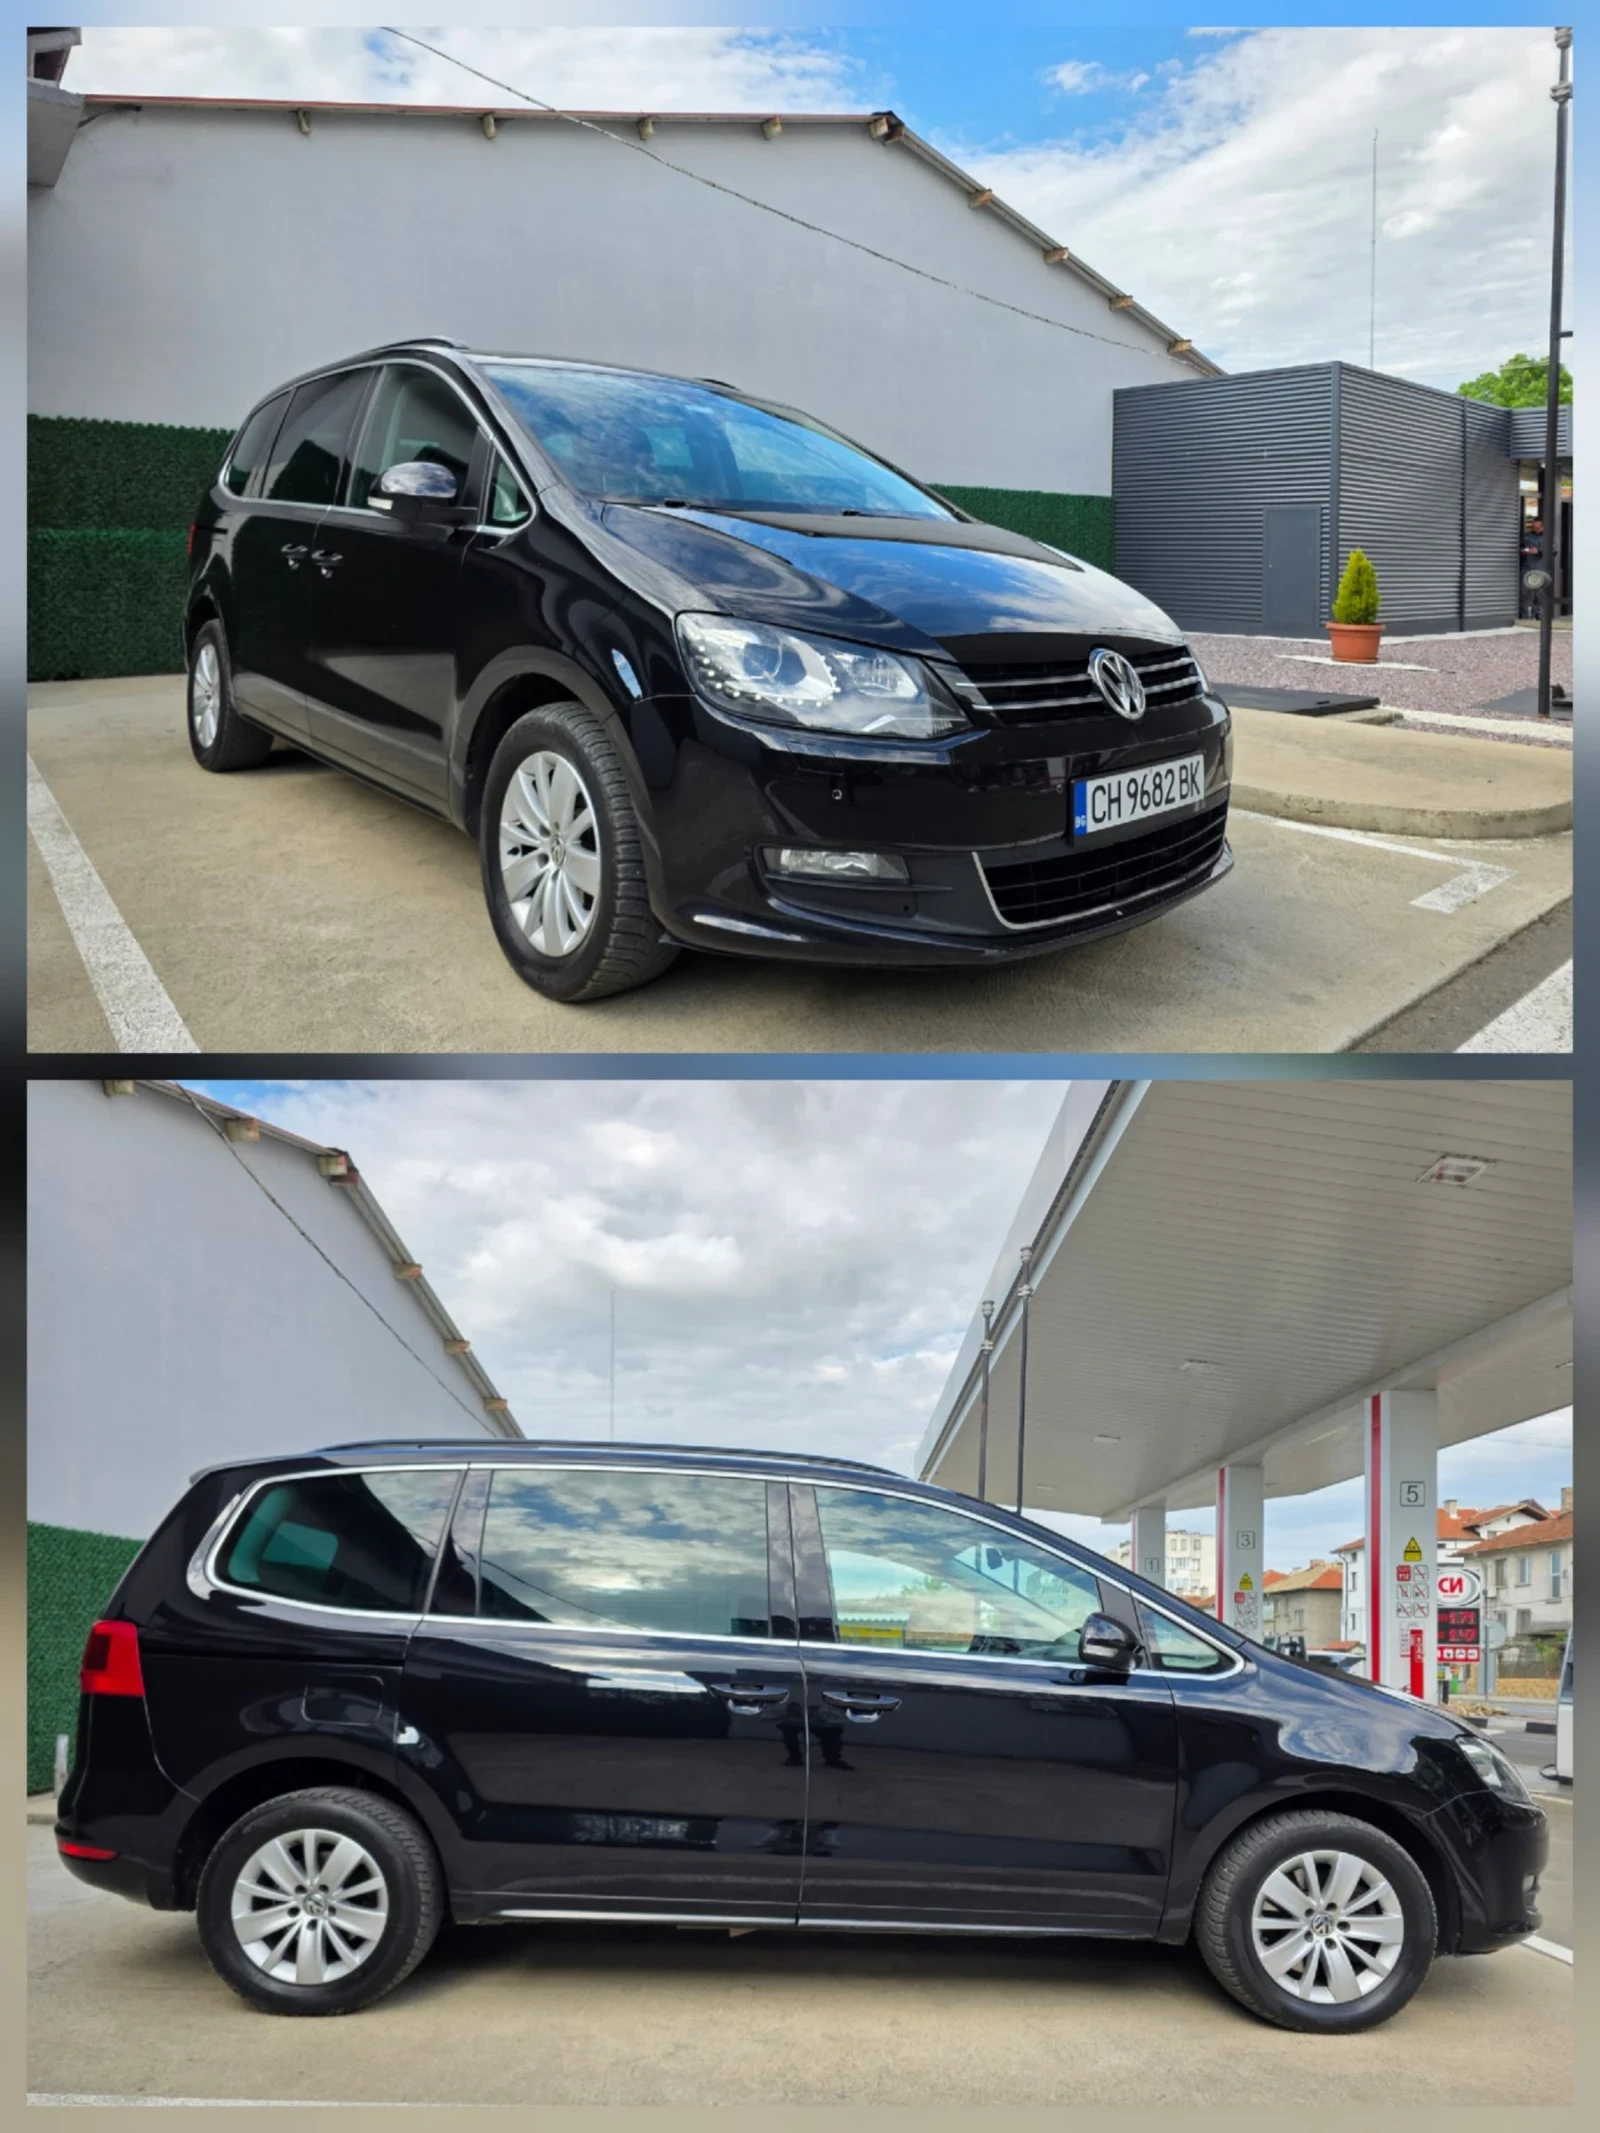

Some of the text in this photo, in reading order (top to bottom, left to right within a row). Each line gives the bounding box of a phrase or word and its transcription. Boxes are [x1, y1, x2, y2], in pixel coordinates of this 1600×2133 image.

[1091, 760, 1200, 823] CH 9682 BK
[1075, 815, 1086, 828] BG
[1406, 1485, 1419, 1503] 5
[1241, 1534, 1251, 1547] 3
[1438, 1577, 1463, 1593] СИ
